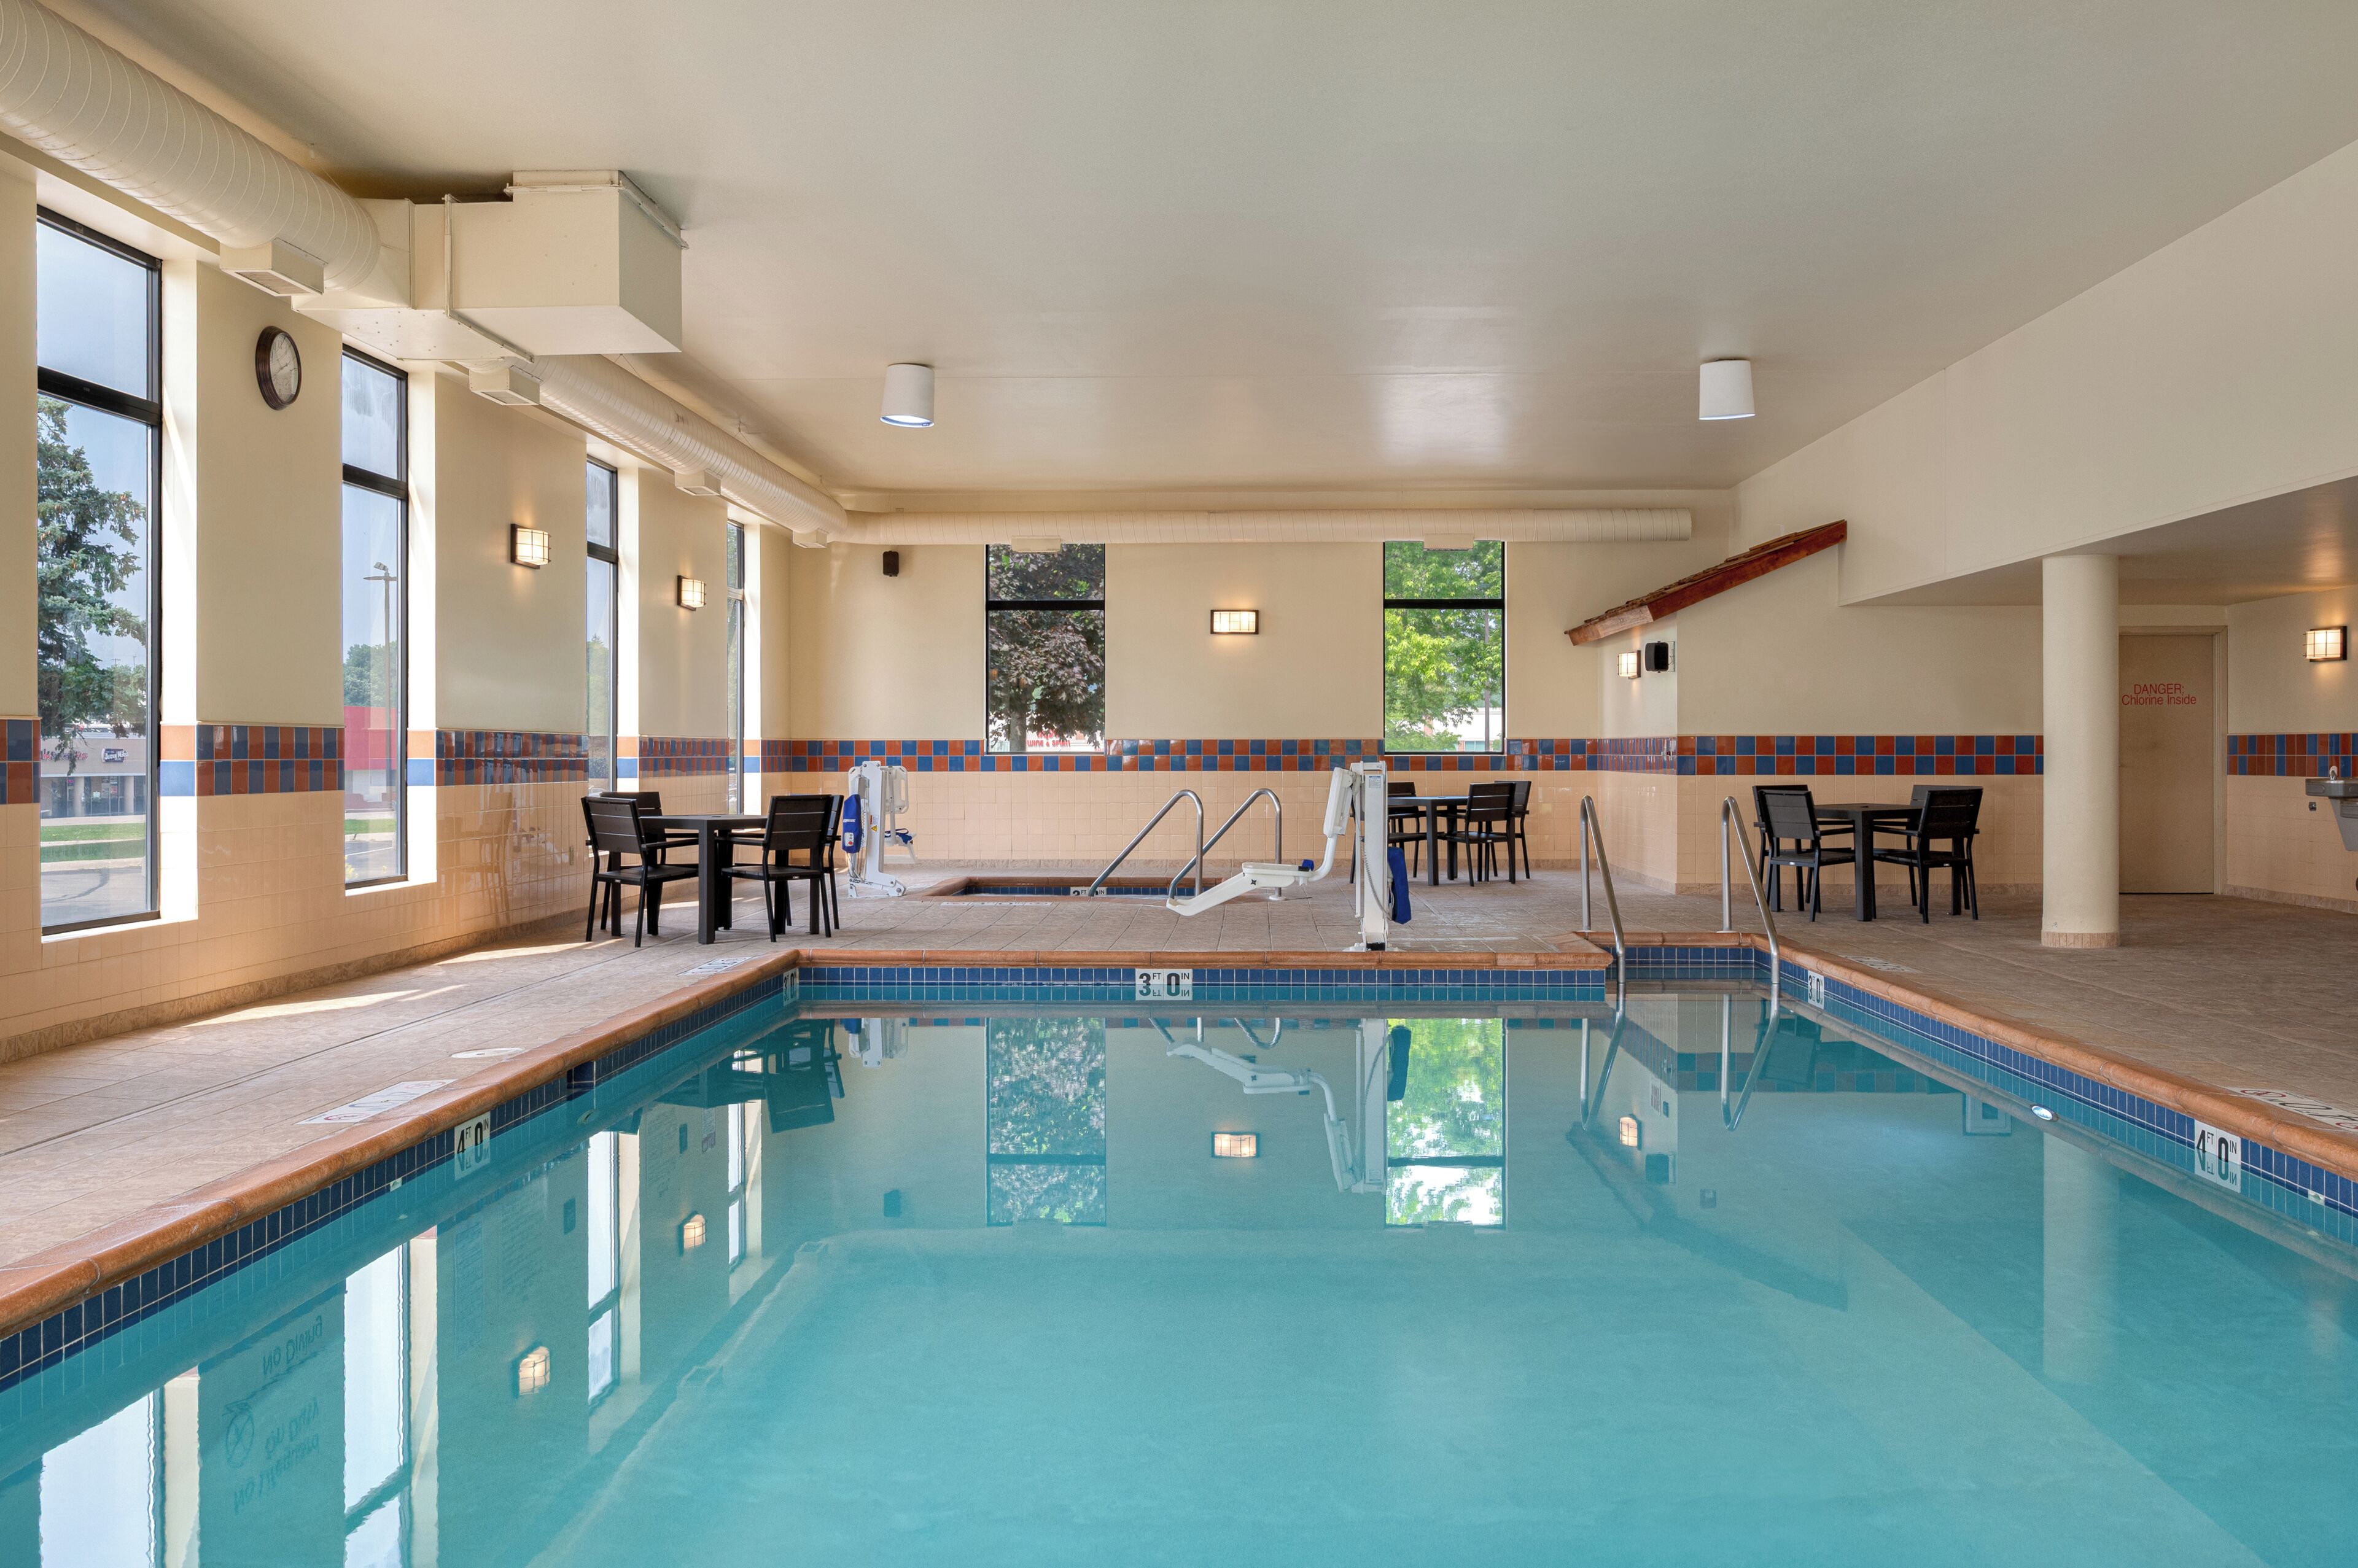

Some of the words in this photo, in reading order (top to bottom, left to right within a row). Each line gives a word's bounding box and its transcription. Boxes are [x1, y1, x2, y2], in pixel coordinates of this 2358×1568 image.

[2134, 683, 2184, 694] DANGER:
[2122, 694, 2163, 705] Chlorine
[2167, 694, 2197, 705] Inside
[1138, 972, 1151, 992] 3
[457, 1129, 466, 1154] 4
[466, 1126, 472, 1140] FT
[483, 1118, 489, 1131] IN
[2196, 1129, 2206, 1153] 4
[2207, 1131, 2214, 1145] FT
[2230, 1140, 2237, 1155] IN
